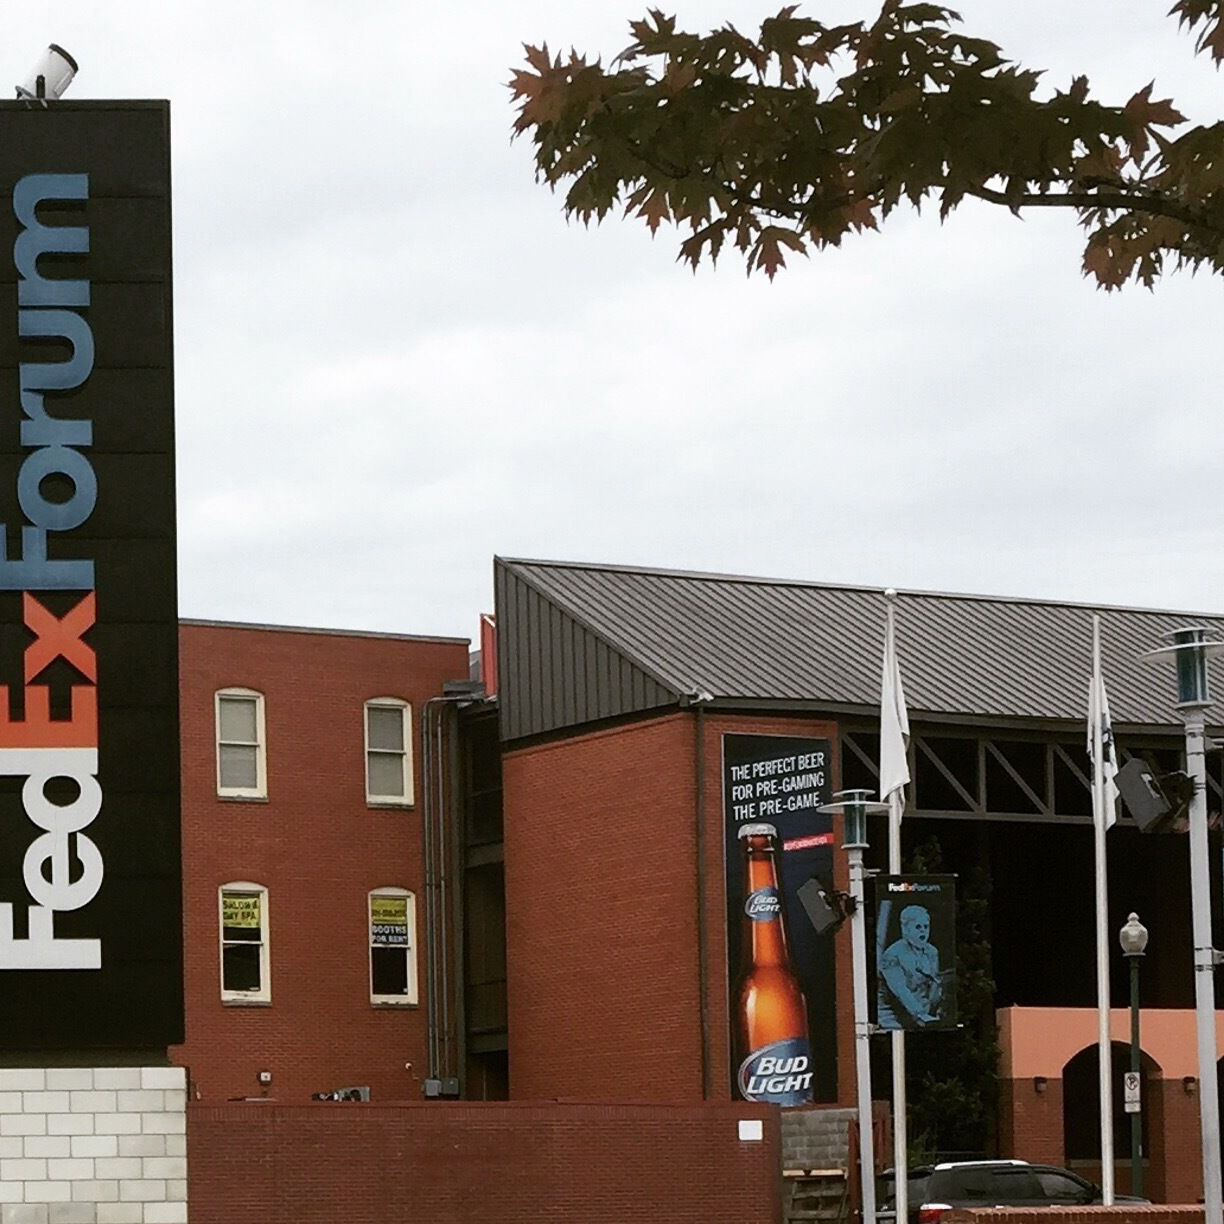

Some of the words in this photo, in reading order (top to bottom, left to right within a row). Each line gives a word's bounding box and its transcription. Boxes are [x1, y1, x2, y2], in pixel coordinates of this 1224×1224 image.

[731, 764, 751, 781] THE
[752, 756, 796, 778] PERFECT
[798, 752, 824, 770] BEER
[733, 784, 753, 801] FOR
[756, 772, 824, 797] PRE-GAMING
[733, 803, 756, 820] THE
[759, 792, 823, 816] PRE-GAME.
[756, 1056, 808, 1076] BUD
[746, 1072, 813, 1094] LIGHT
